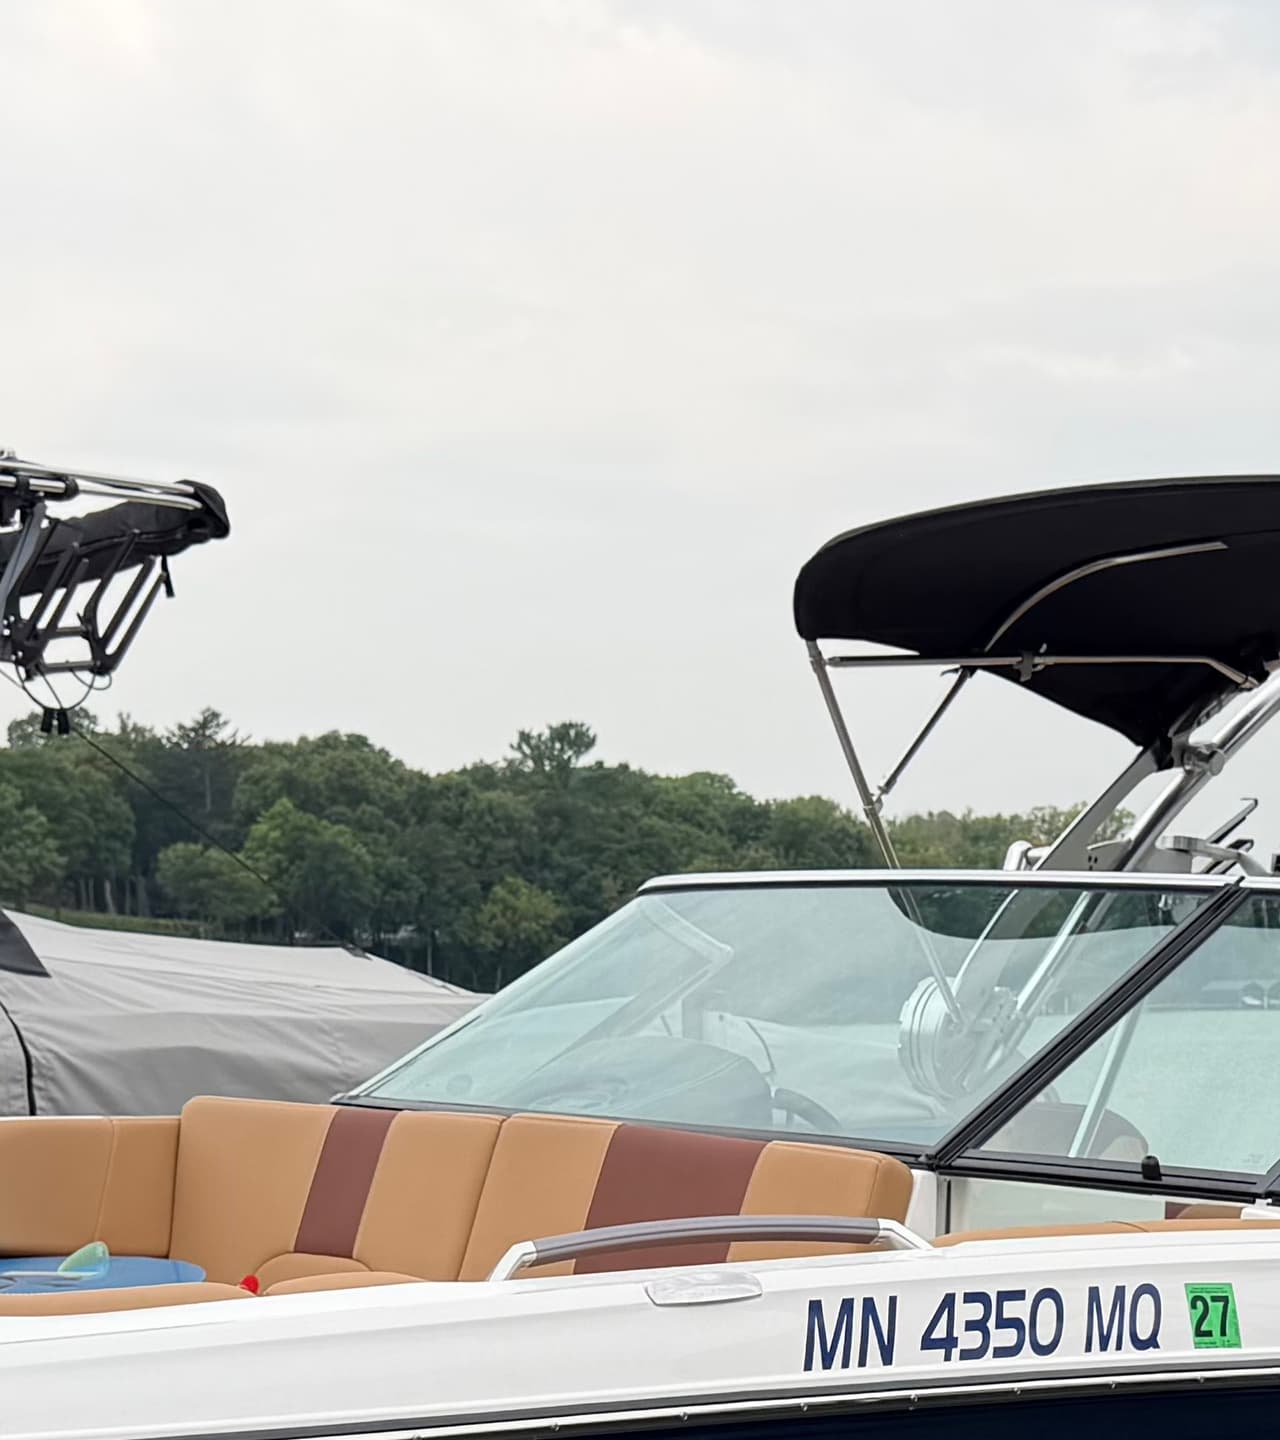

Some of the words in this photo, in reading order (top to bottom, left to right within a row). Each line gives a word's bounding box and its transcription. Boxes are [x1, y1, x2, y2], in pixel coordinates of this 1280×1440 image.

[803, 1295, 898, 1371] MN
[920, 1287, 1064, 1362] 4350
[1084, 1283, 1161, 1353] MQ
[1190, 1295, 1229, 1337] 27
